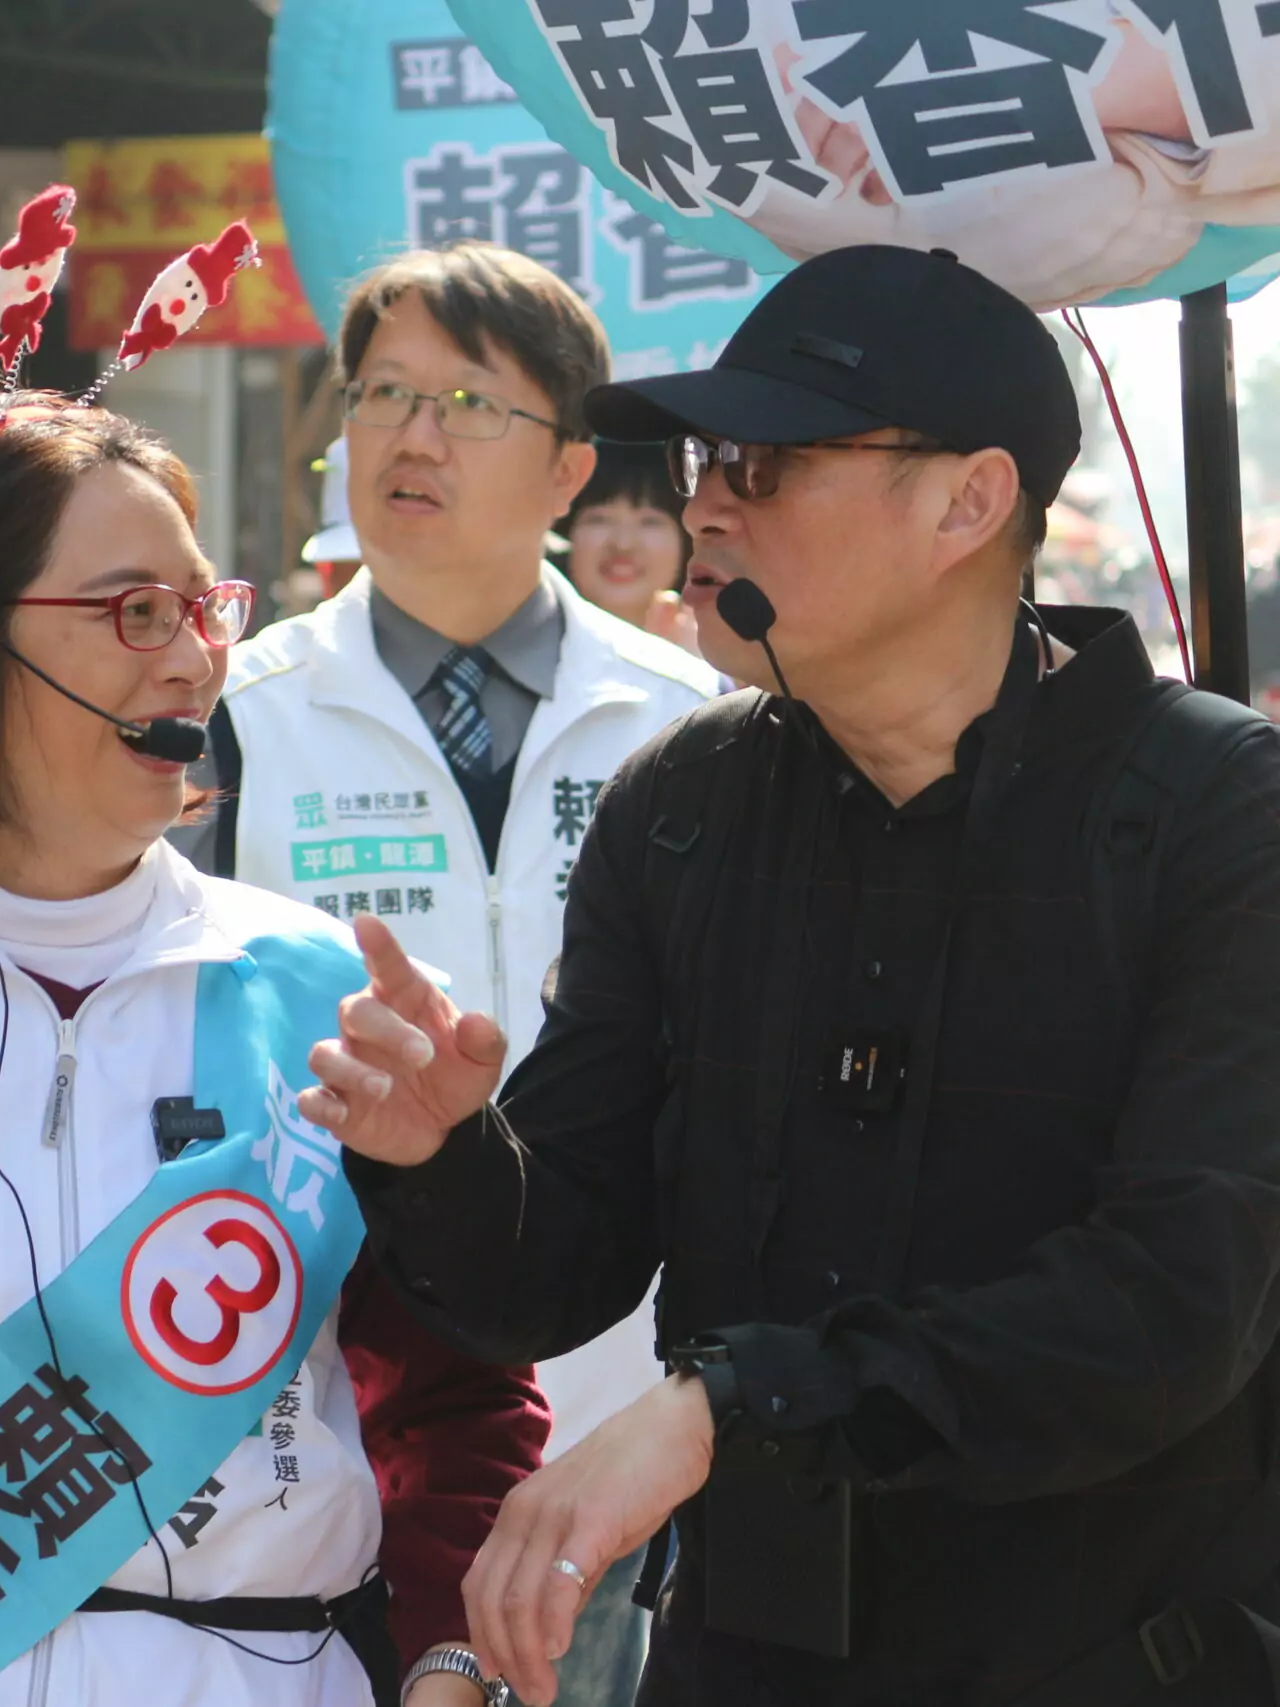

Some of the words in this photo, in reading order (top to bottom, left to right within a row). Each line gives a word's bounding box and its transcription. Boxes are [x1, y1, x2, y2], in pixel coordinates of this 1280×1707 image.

[314, 887, 435, 918] 服務團隊
[149, 1217, 281, 1367] 3
